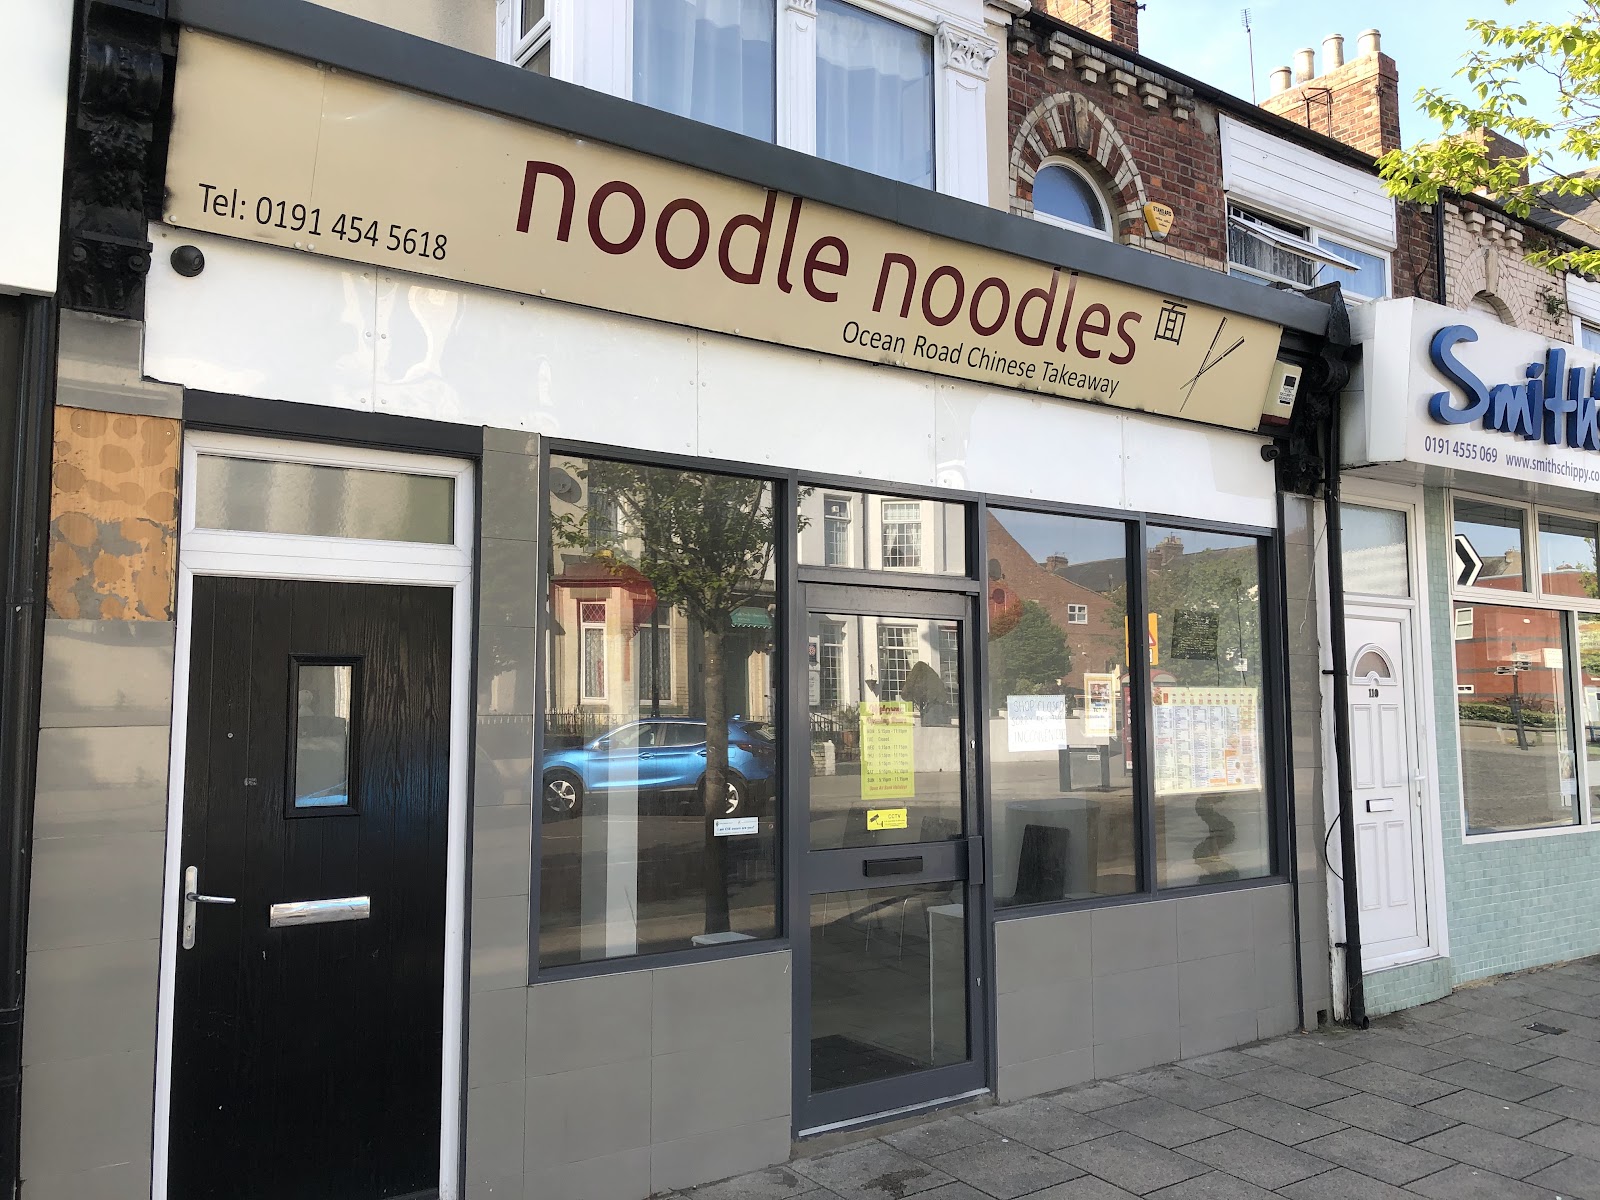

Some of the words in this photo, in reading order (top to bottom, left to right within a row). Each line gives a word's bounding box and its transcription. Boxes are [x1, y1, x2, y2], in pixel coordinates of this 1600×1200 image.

[198, 182, 247, 220] Tel:
[255, 196, 322, 236] 0191
[331, 213, 379, 247] 454
[386, 224, 448, 260] 5618
[516, 160, 849, 303] noodle
[872, 252, 1143, 365] noodles
[842, 320, 906, 354] Ocean
[912, 334, 964, 366] Road
[966, 346, 1036, 379] Chinese
[1041, 360, 1120, 399] Takeaway
[1428, 324, 1600, 452] Smith
[1424, 435, 1450, 455] 0191
[1452, 441, 1477, 460] 4555
[1479, 446, 1498, 463] 069
